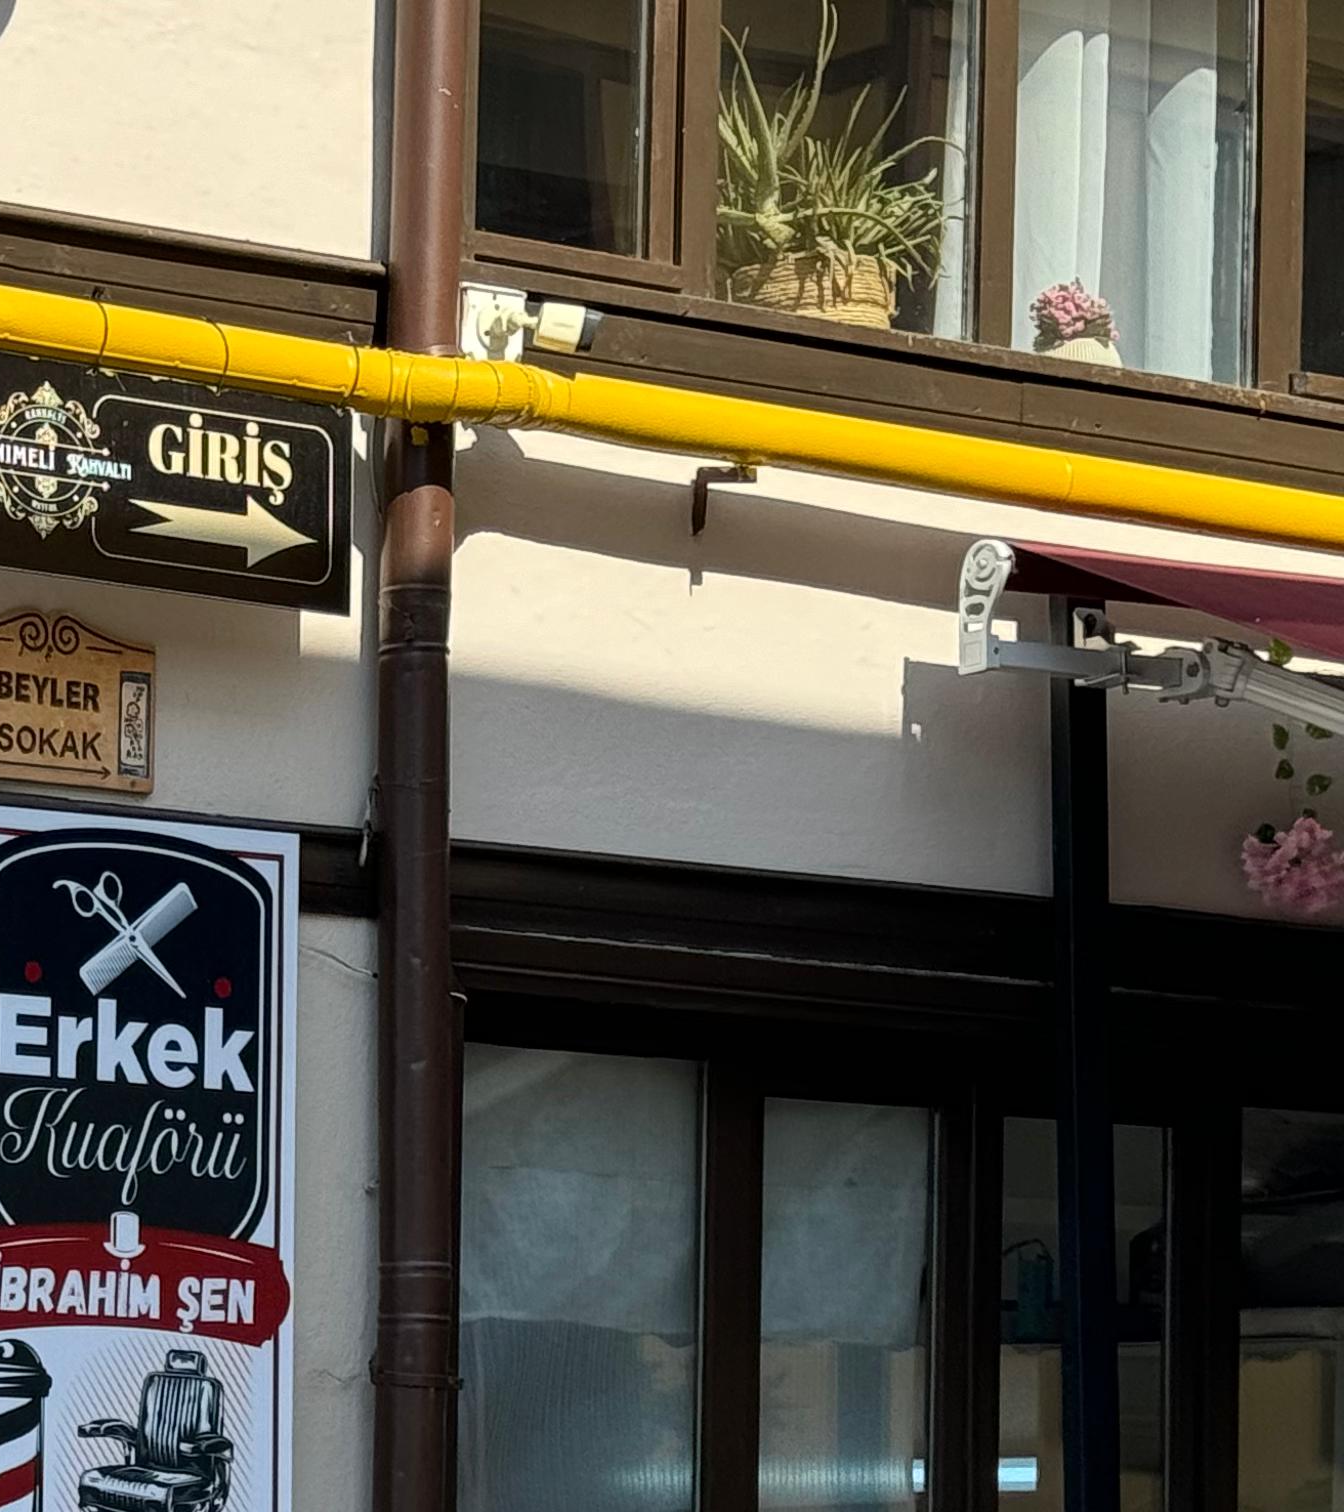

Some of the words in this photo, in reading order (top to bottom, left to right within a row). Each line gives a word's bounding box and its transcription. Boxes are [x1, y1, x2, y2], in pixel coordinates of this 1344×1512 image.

[66, 453, 132, 481] KAHVALTI
[148, 413, 293, 506] GİRİŞ
[0, 1086, 248, 1205] Kuaförü
[176, 1276, 255, 1333] ŞEN
